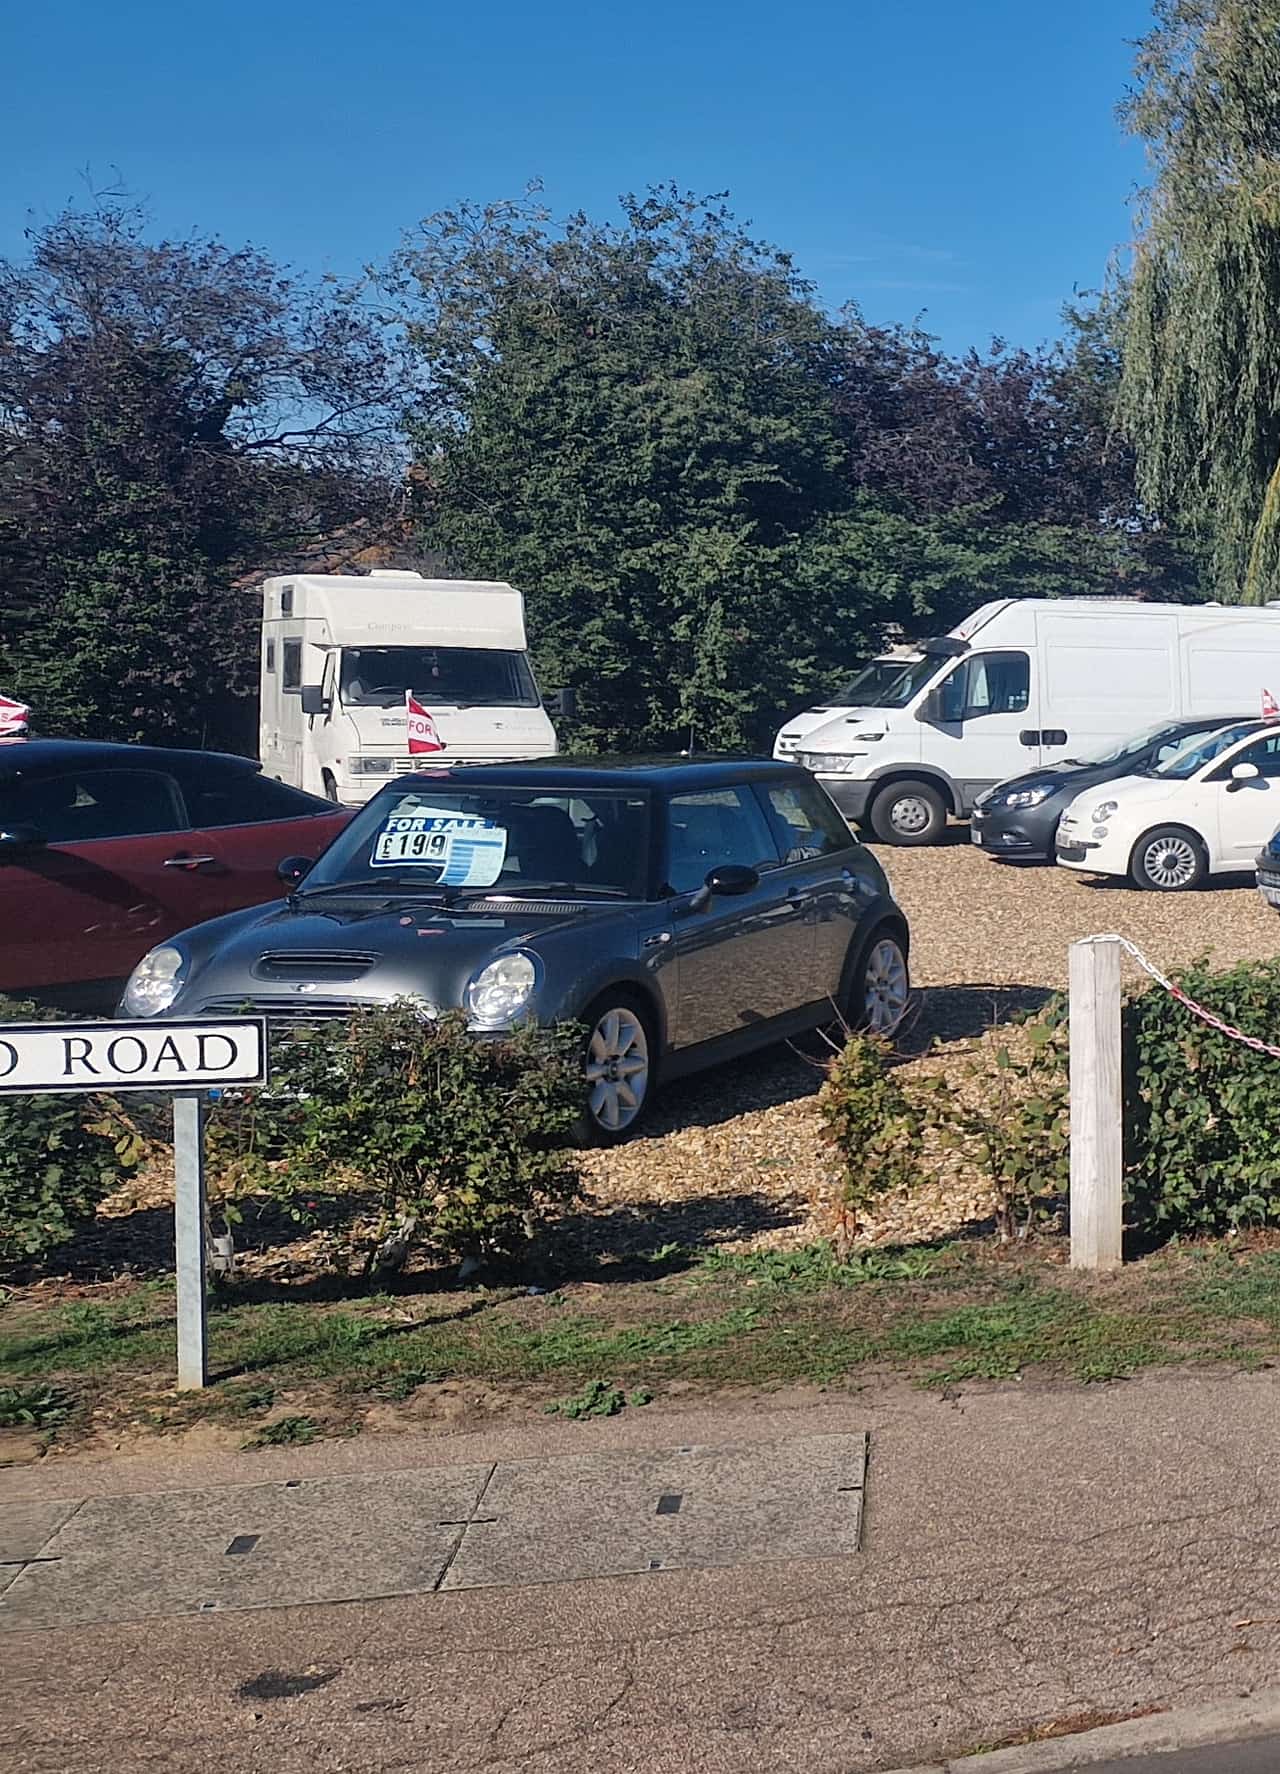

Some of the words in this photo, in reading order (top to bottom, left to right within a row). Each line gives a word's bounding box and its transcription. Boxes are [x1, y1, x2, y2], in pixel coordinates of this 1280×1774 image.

[409, 720, 433, 736] FOR
[386, 819, 427, 832] FOR
[62, 1034, 238, 1076] ROAD
